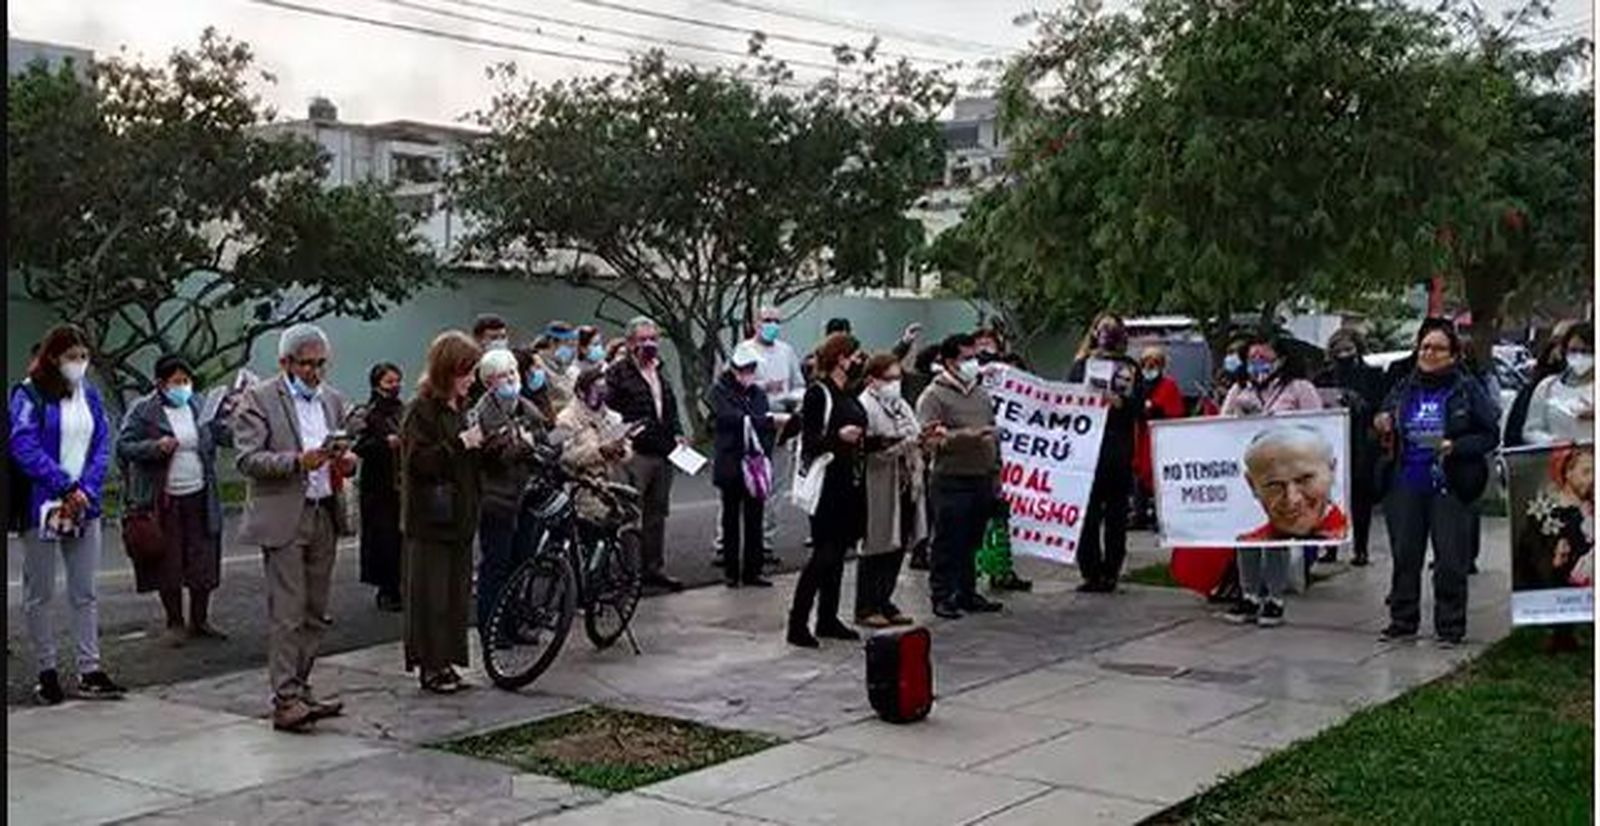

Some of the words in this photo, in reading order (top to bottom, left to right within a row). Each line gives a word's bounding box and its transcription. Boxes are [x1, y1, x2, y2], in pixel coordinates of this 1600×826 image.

[991, 394, 1023, 422] TE
[1027, 409, 1092, 435] AMO
[1025, 468, 1052, 493] AL
[1163, 464, 1182, 481] NO
[1185, 460, 1240, 480] TENGAN
[1181, 485, 1228, 504] MIEDO
